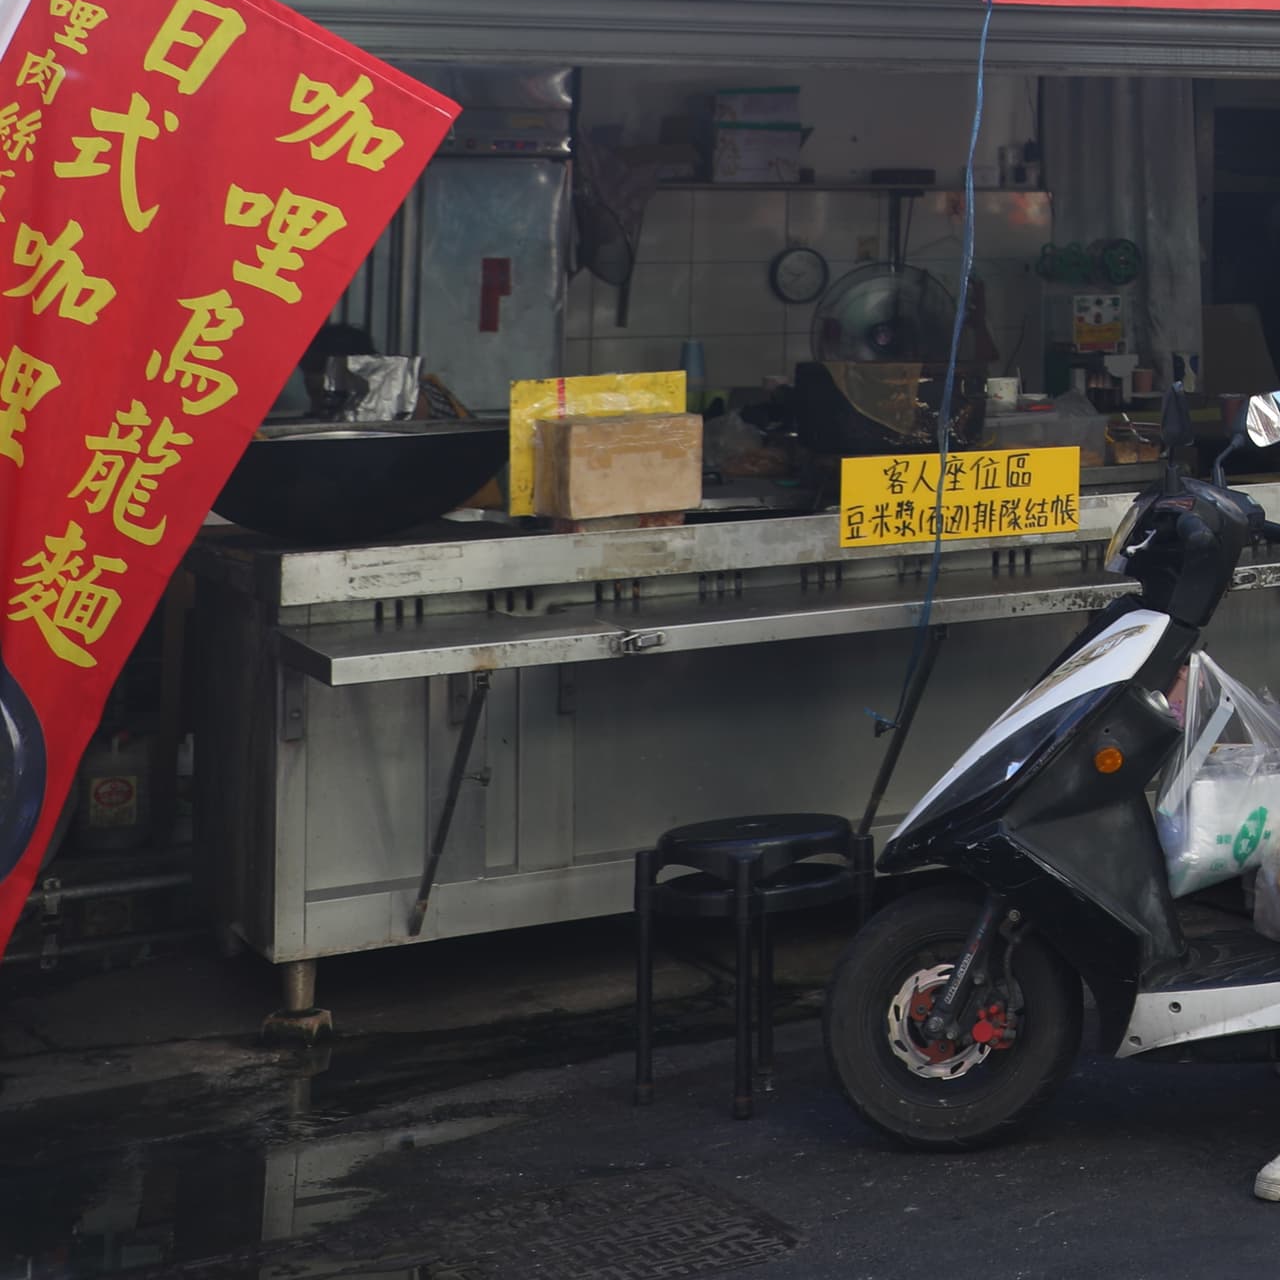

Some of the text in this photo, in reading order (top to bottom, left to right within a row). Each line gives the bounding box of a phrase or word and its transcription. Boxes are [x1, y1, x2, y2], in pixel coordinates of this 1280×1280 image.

[7, 73, 405, 669] 咖哩烏龍麵
[883, 453, 1032, 495] 客人座位區
